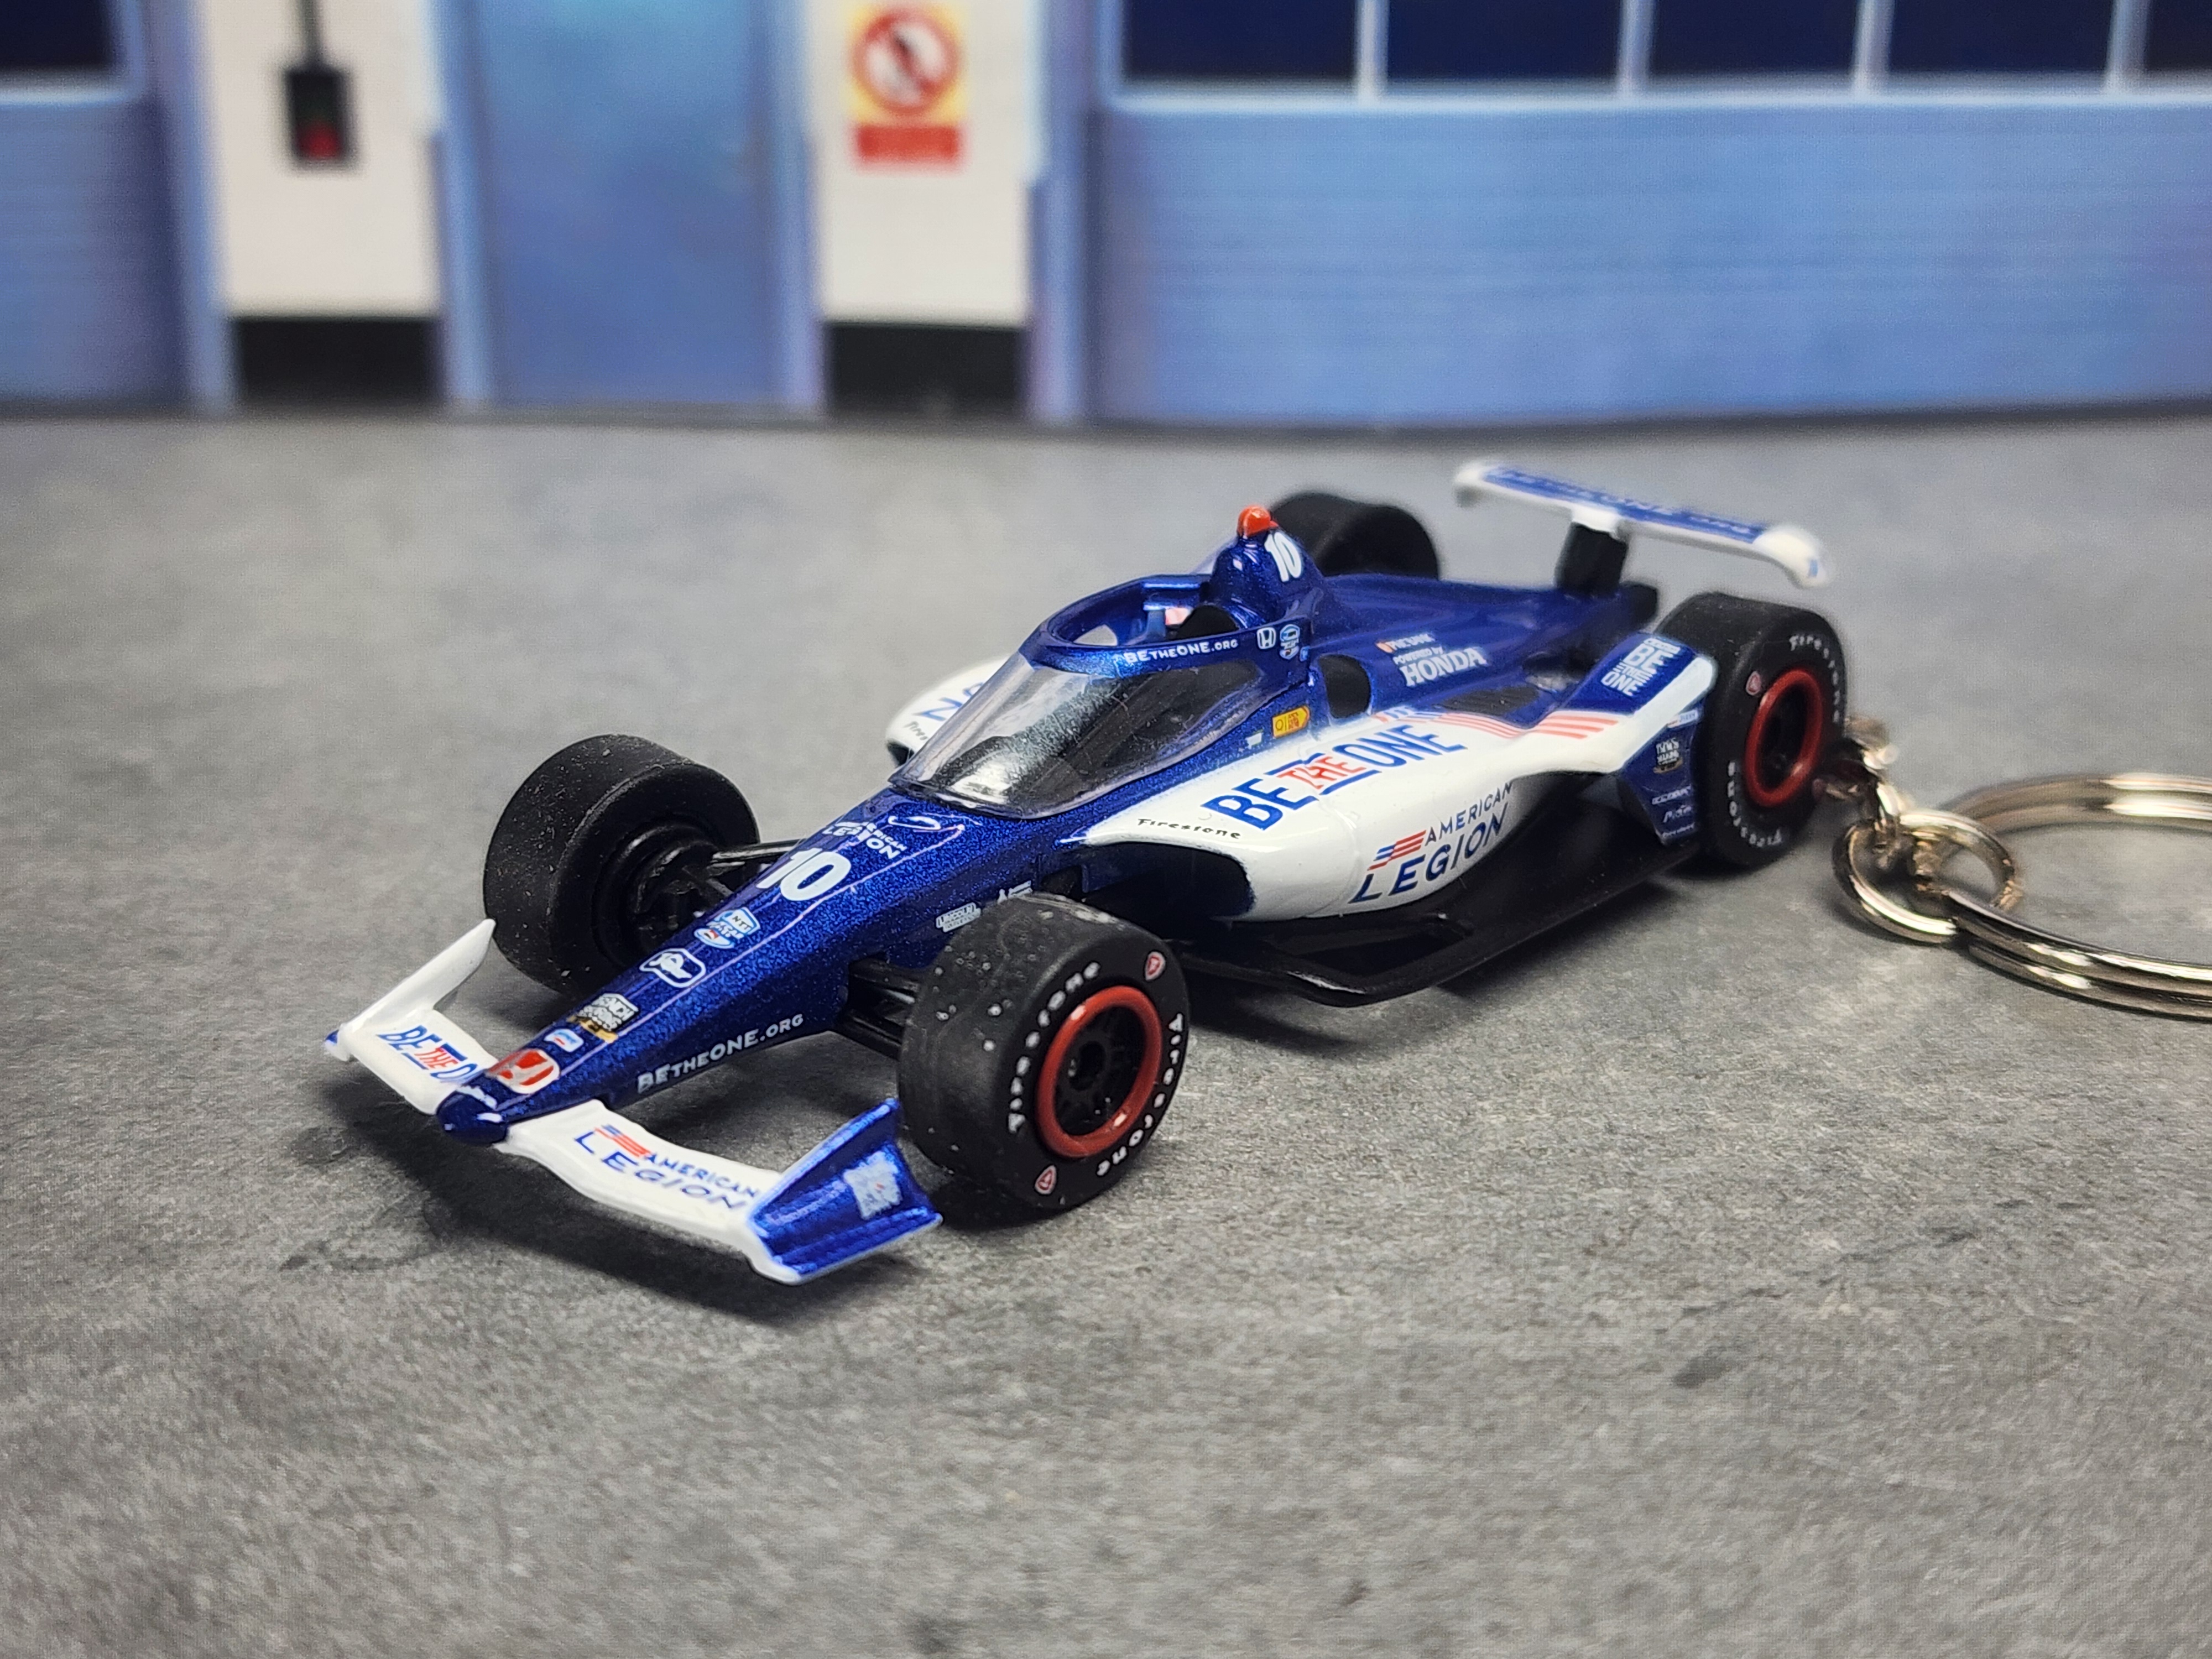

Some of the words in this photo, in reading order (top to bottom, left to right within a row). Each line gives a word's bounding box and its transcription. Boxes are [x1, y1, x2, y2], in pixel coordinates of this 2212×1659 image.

[1264, 532, 1304, 582] 10
[1399, 648, 1488, 687] HONDA
[1623, 643, 1674, 675] BE
[1600, 671, 1644, 697] ONE
[1138, 818, 1241, 840] Firestone
[1425, 781, 1512, 847] AMERICAN
[755, 847, 852, 901] 10
[1347, 801, 1509, 905] LEGION
[573, 1130, 747, 1209] LEGION
[644, 1152, 760, 1198] AMERICAN
